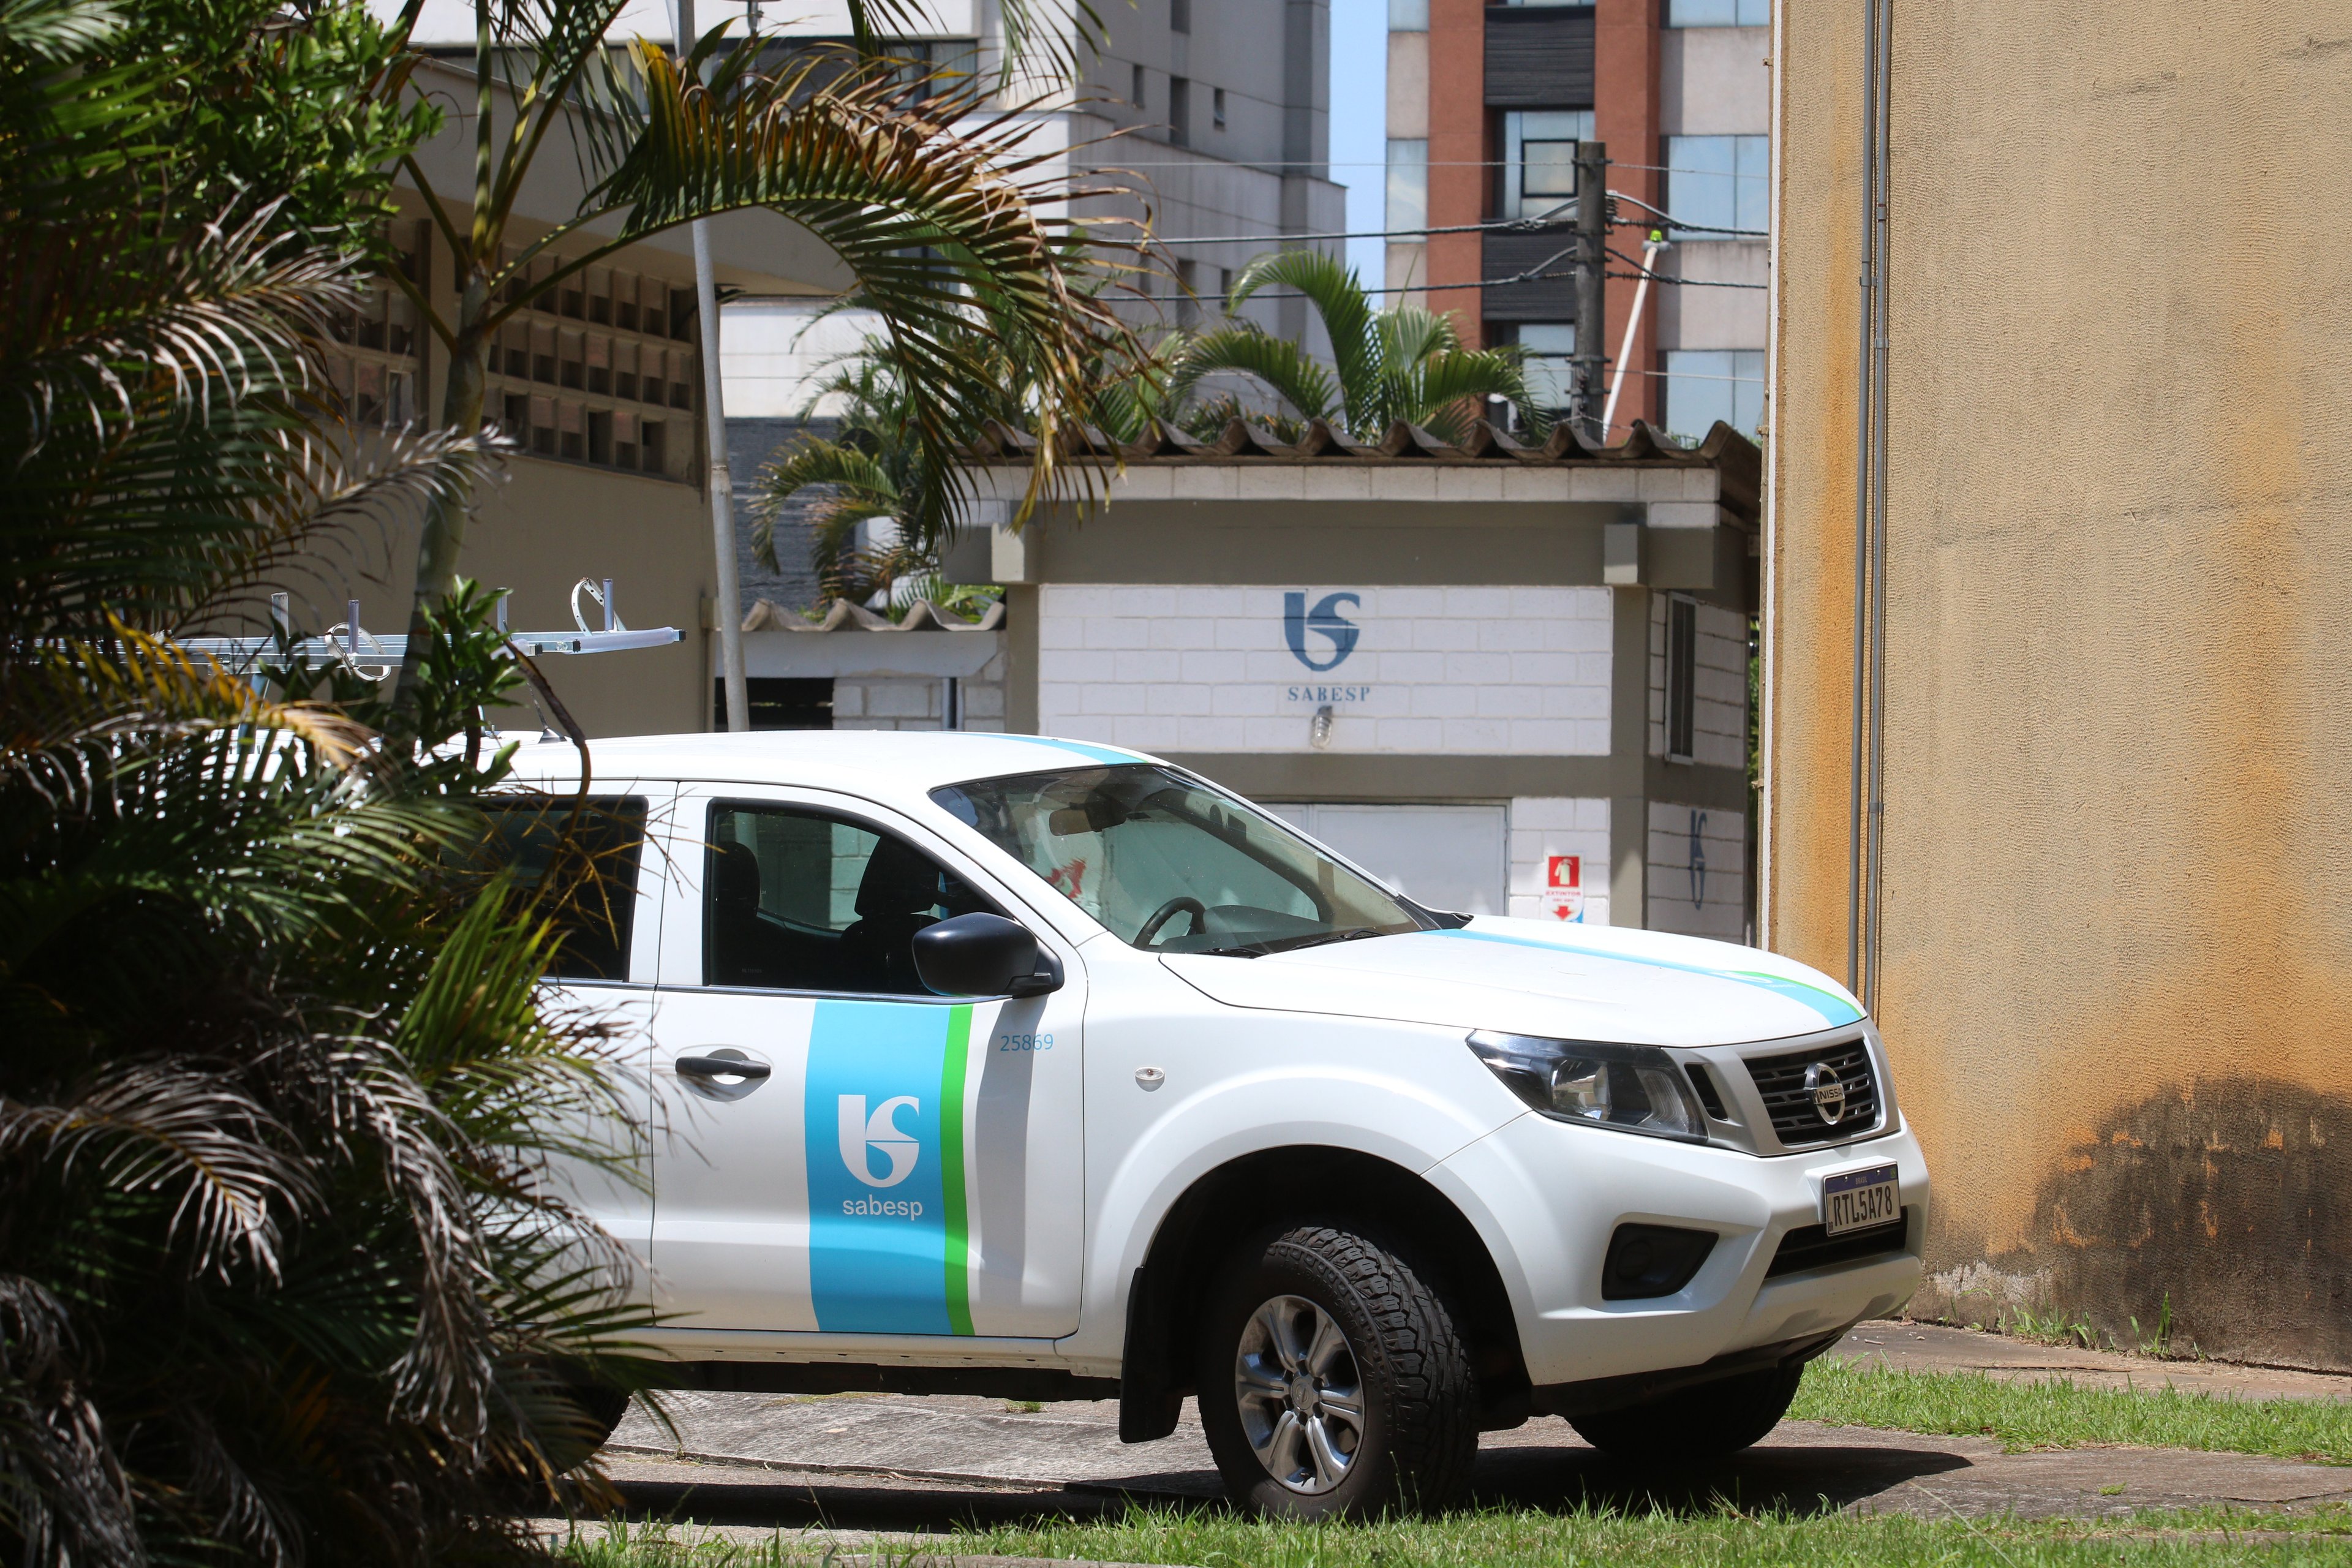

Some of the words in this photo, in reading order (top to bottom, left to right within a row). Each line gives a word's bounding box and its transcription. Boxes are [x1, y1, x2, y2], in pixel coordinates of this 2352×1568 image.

[1287, 686, 1371, 702] SABESP
[1000, 1033, 1054, 1052] 25869
[1819, 1087, 1844, 1100] NISSA
[842, 1194, 924, 1221] sabesp
[1833, 1185, 1893, 1227] RTL5A78
